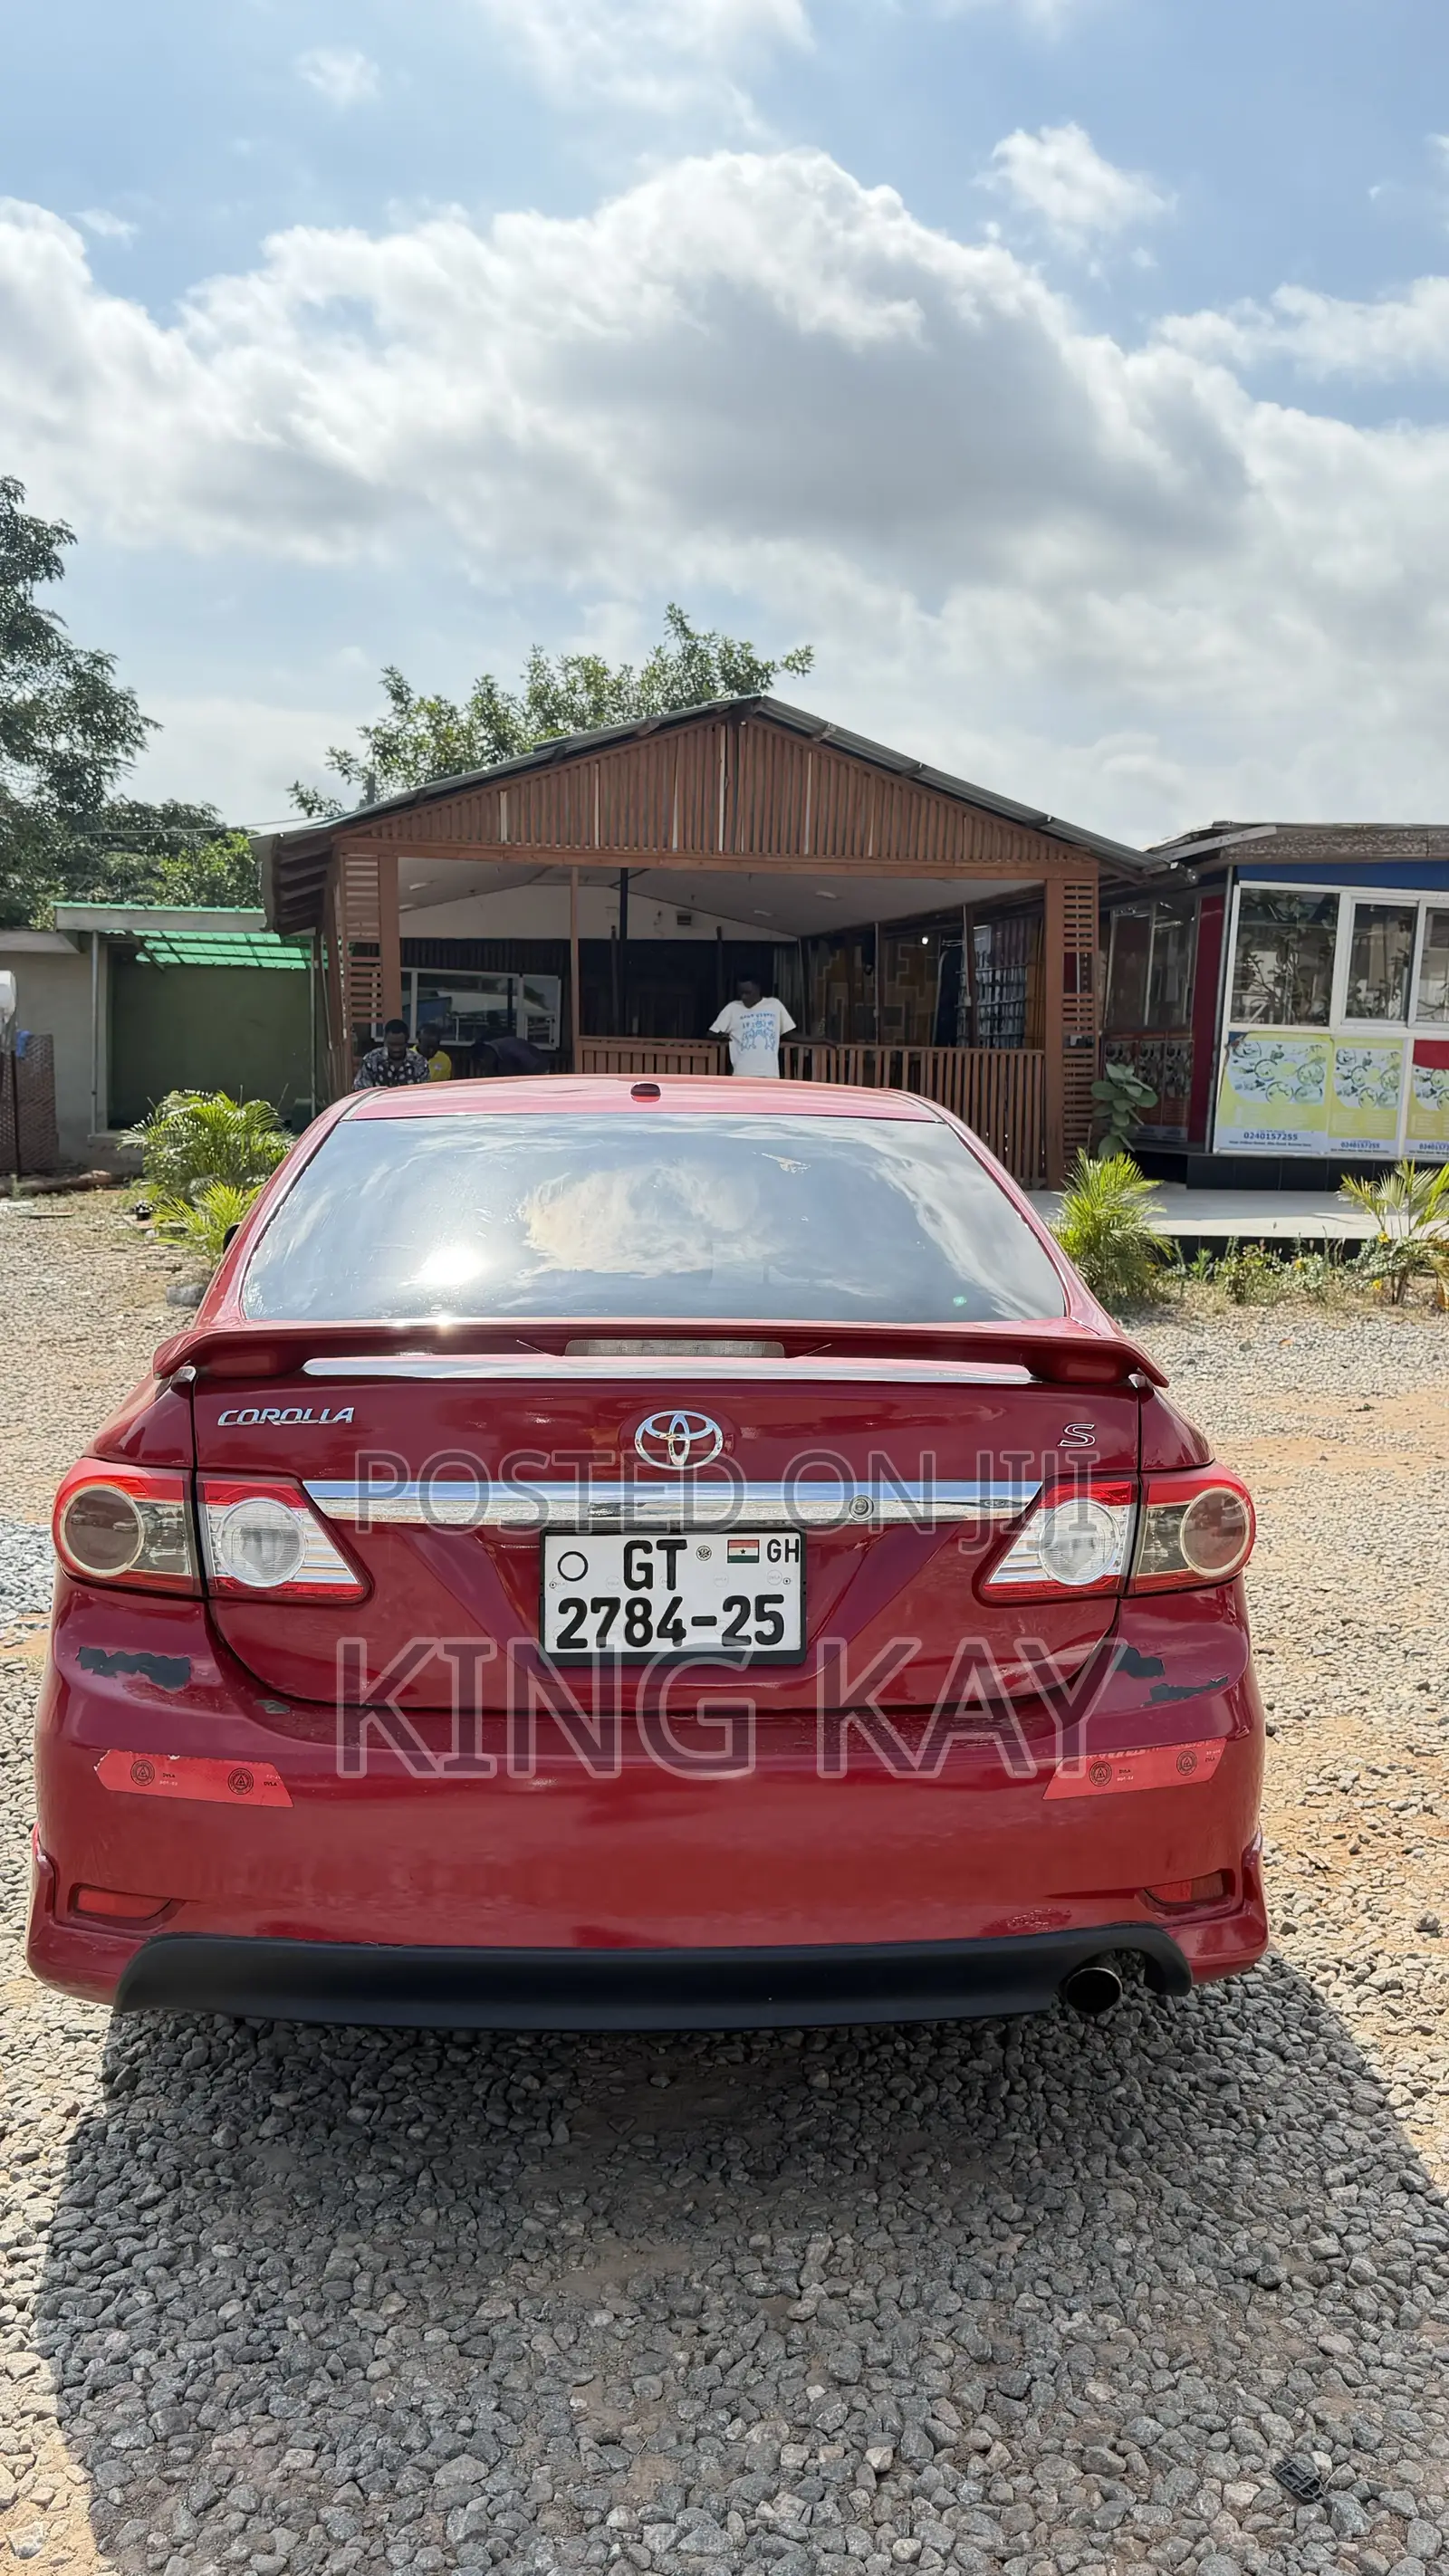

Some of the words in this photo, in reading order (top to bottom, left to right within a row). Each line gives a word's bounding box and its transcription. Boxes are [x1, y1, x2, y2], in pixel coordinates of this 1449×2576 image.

[1243, 1132, 1298, 1141] 0240157255
[217, 1407, 355, 1426] COROLLA
[1058, 1423, 1096, 1447] S
[767, 1538, 800, 1563] GH
[623, 1539, 687, 1591] GT
[556, 1594, 785, 1649] 2784-25
